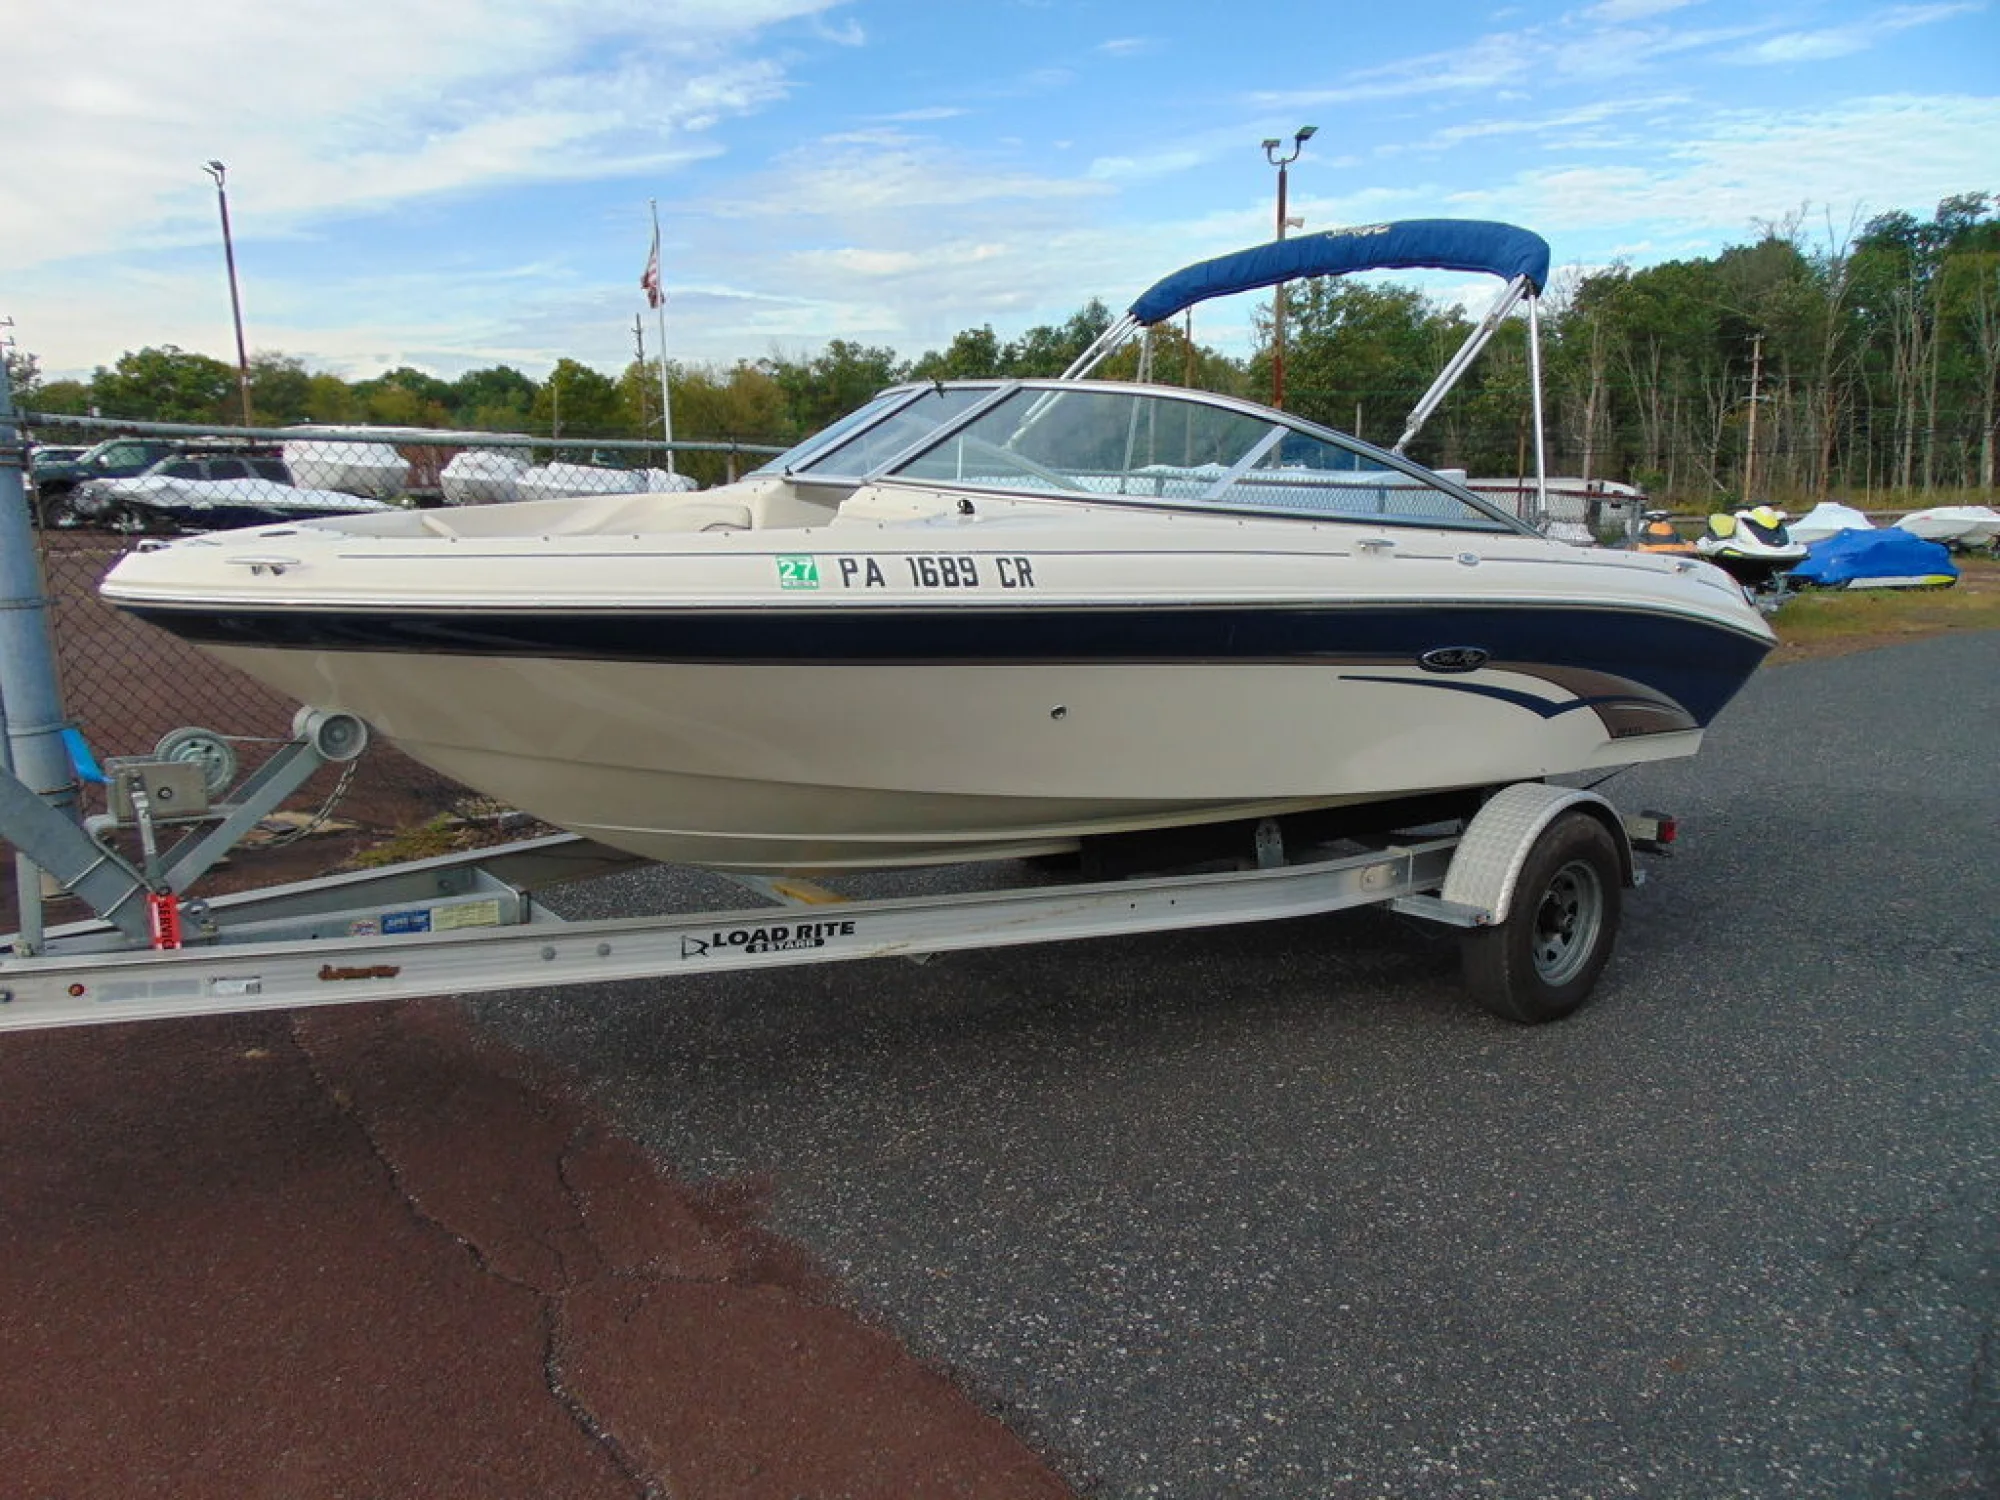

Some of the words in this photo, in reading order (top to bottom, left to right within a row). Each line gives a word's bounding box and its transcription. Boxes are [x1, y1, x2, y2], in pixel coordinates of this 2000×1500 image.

[780, 561, 813, 579] 27
[838, 557, 886, 588] PA
[906, 556, 979, 588] 1689
[996, 558, 1035, 588] CR
[712, 927, 789, 948] LOAD
[797, 921, 856, 939] RITE
